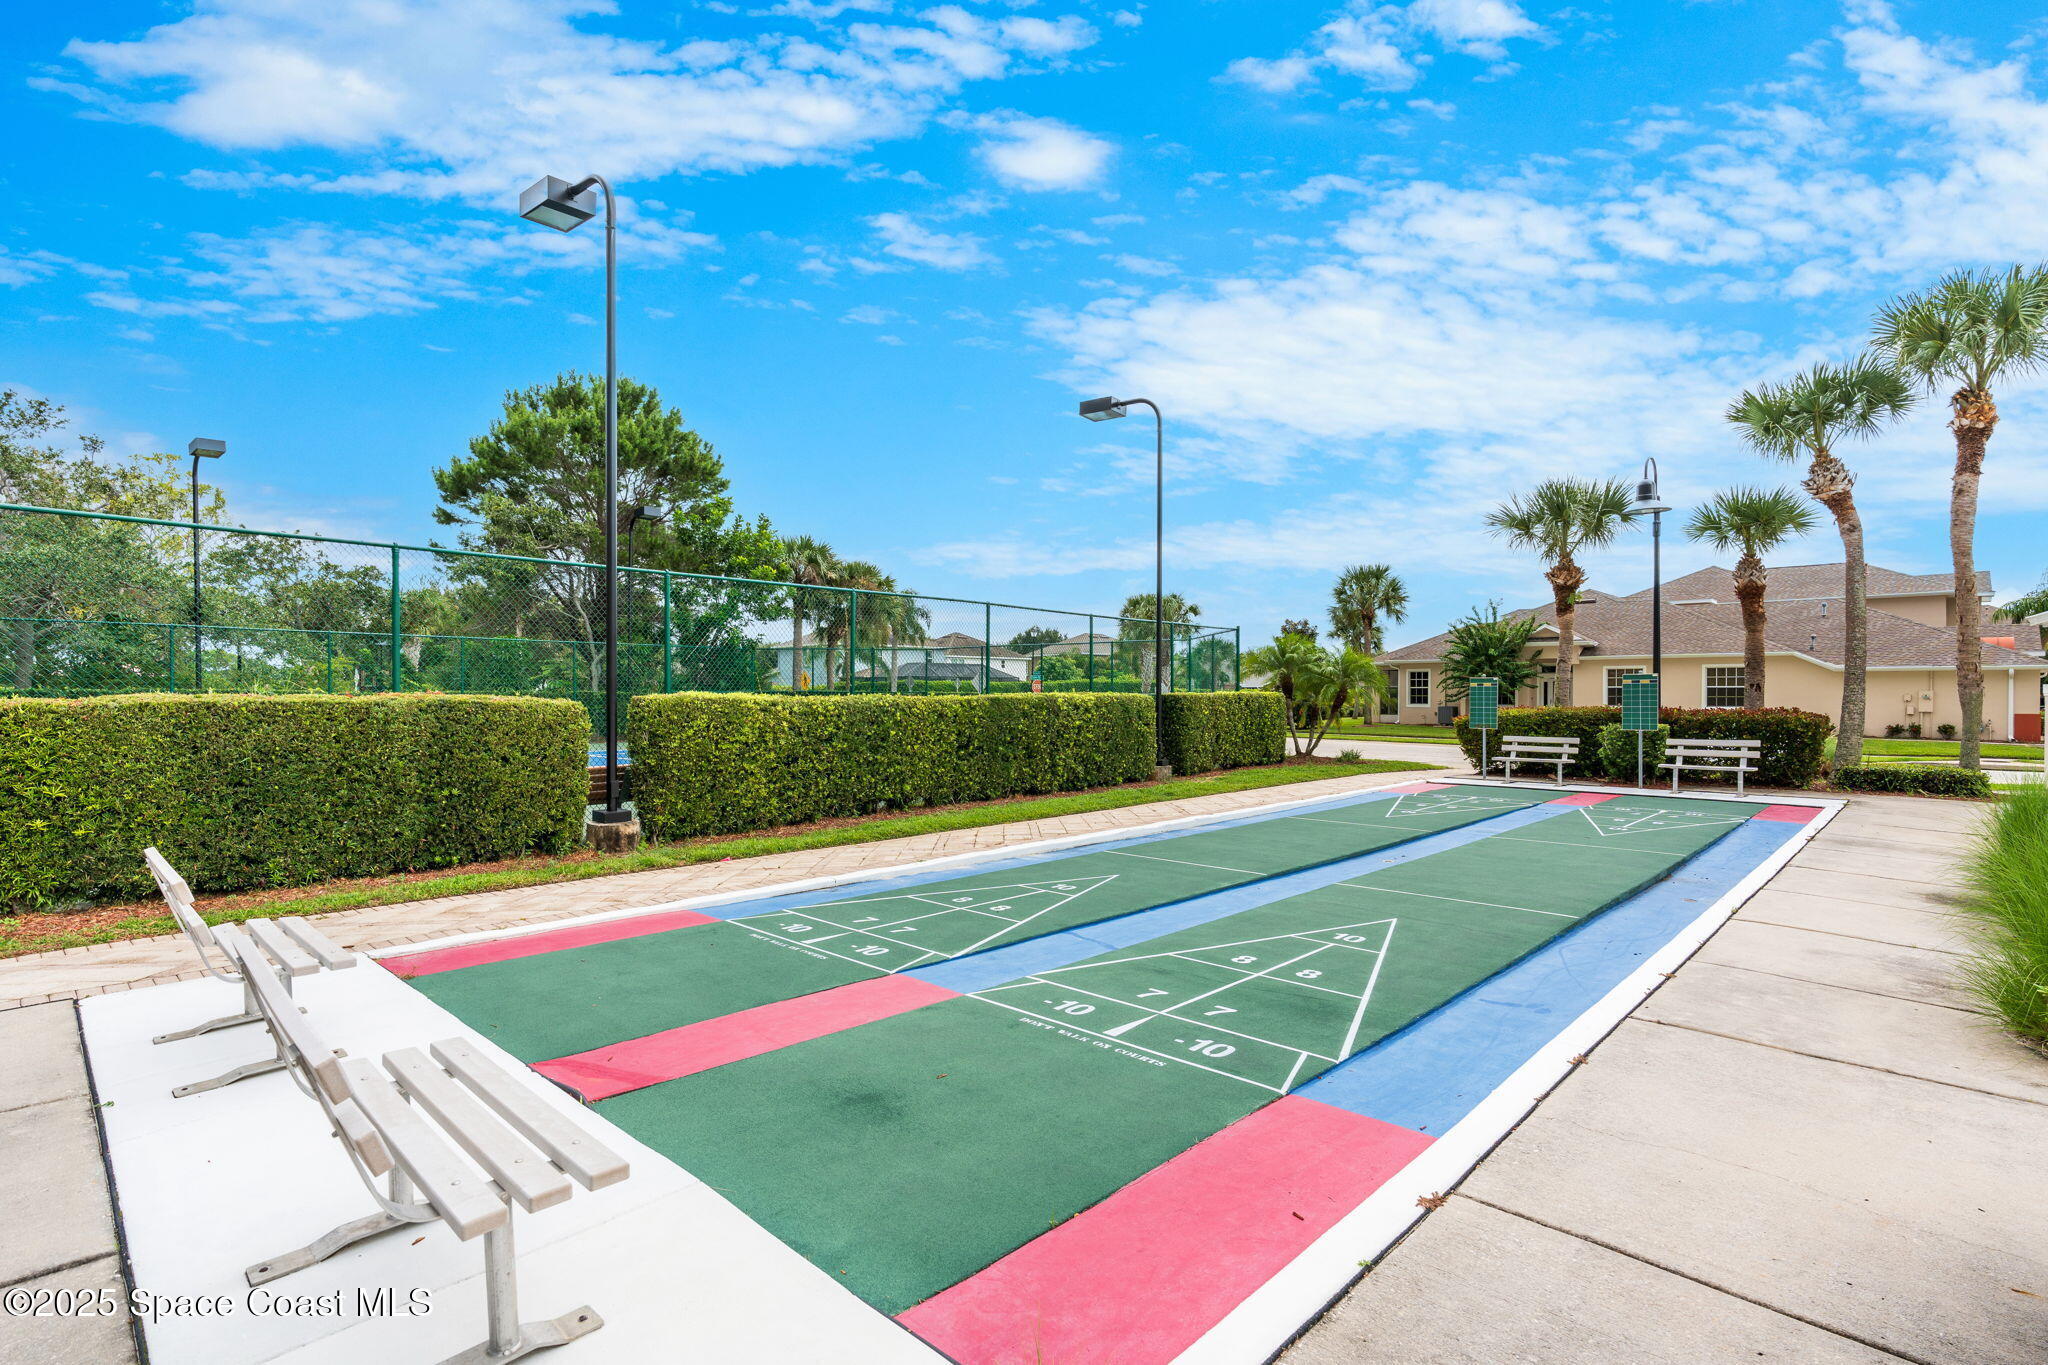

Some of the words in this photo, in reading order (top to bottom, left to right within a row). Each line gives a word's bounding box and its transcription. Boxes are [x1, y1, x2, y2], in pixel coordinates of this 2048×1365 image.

[1051, 883, 1077, 891] 10
[779, 923, 813, 933] -10
[1332, 933, 1367, 943] 10
[851, 945, 890, 956] -10
[1231, 955, 1258, 964] 8
[1295, 969, 1322, 979] 8
[1136, 988, 1169, 998] 7
[1043, 1000, 1096, 1015] -10
[1203, 1005, 1238, 1016] 7
[1058, 1029, 1090, 1042] WALK
[1092, 1040, 1112, 1049] ON
[1114, 1048, 1168, 1067] COURTS
[1174, 1038, 1236, 1058] -10
